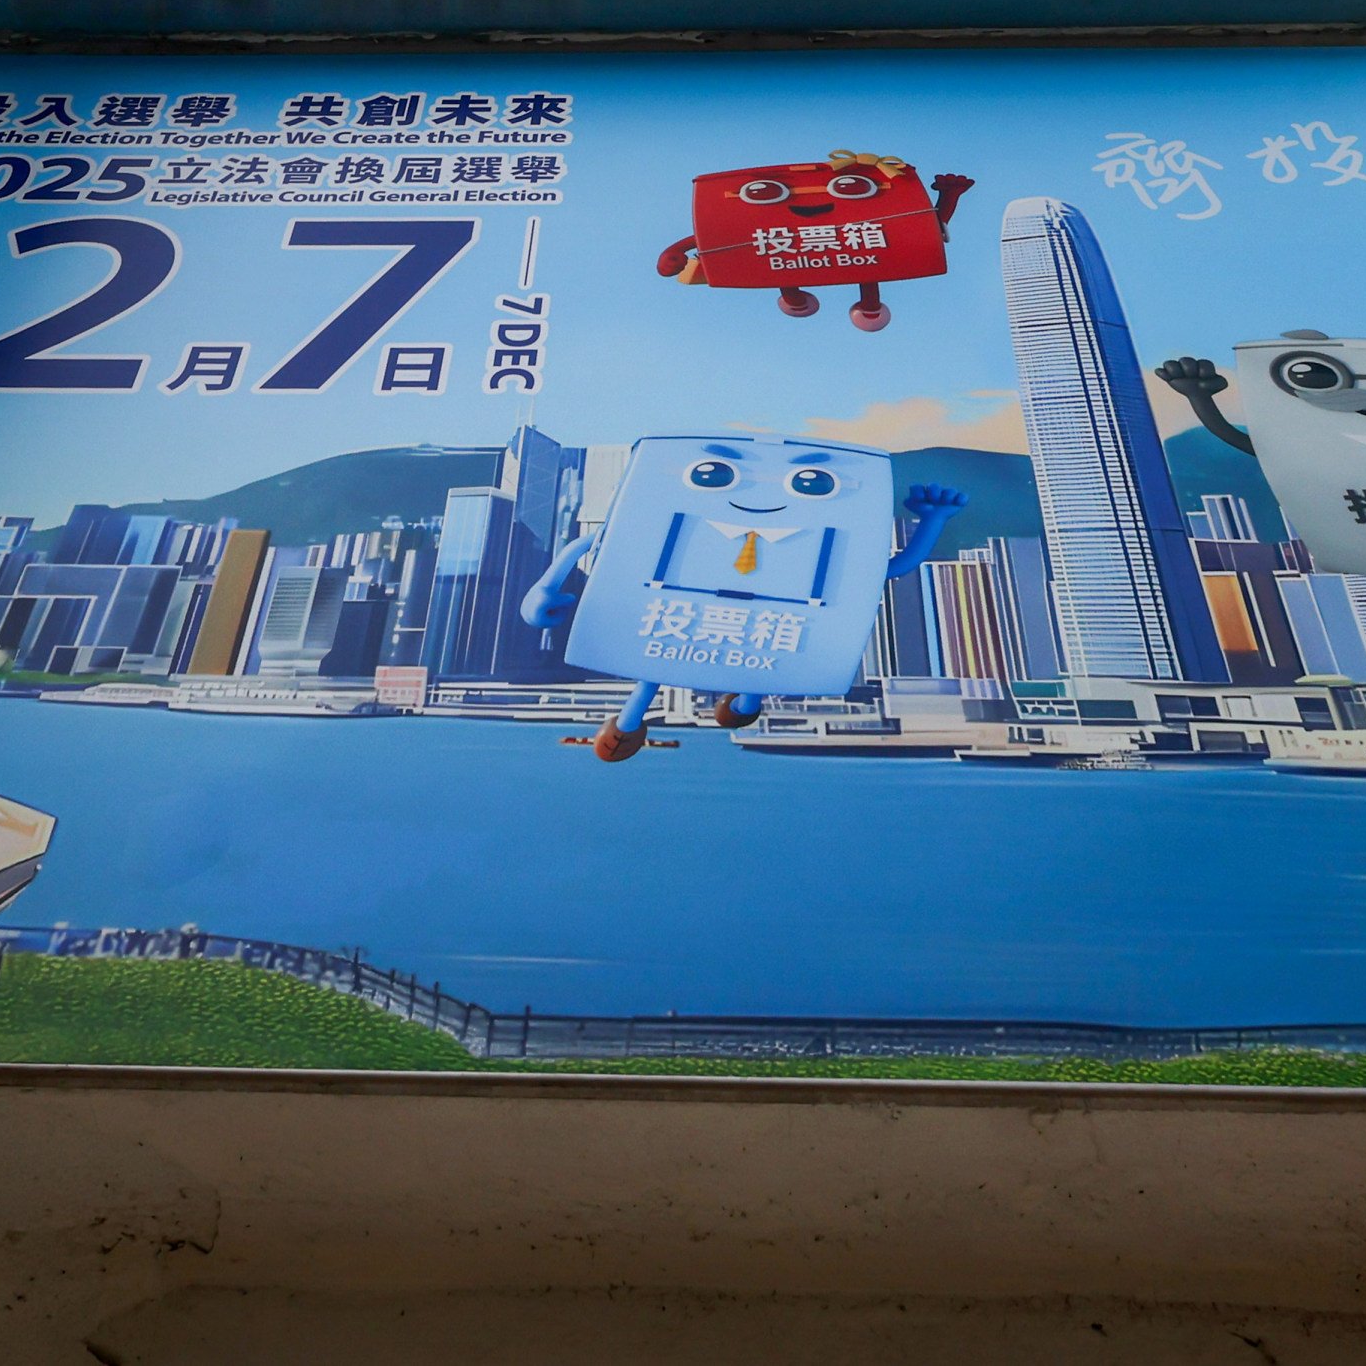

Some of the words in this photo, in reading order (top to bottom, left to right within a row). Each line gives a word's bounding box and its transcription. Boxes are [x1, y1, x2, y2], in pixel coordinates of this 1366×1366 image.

[283, 94, 568, 127] 共創未來
[44, 131, 154, 145] Election
[159, 132, 280, 148] Together
[286, 132, 327, 145] We
[333, 131, 420, 145] Create
[427, 131, 471, 144] the
[477, 130, 567, 144] Future
[157, 155, 561, 185] 立法會換屆選舉
[150, 190, 274, 204] Legislative
[280, 190, 364, 203] Council
[369, 190, 459, 202] General
[464, 189, 558, 202] Election
[752, 221, 887, 256] 投票箱
[769, 254, 831, 270] Ballot
[836, 253, 878, 267] Box
[502, 297, 544, 315] 7
[489, 324, 542, 390] DEC
[638, 597, 807, 653] 投票箱
[644, 640, 719, 664] Ballot
[724, 649, 777, 670] Box
